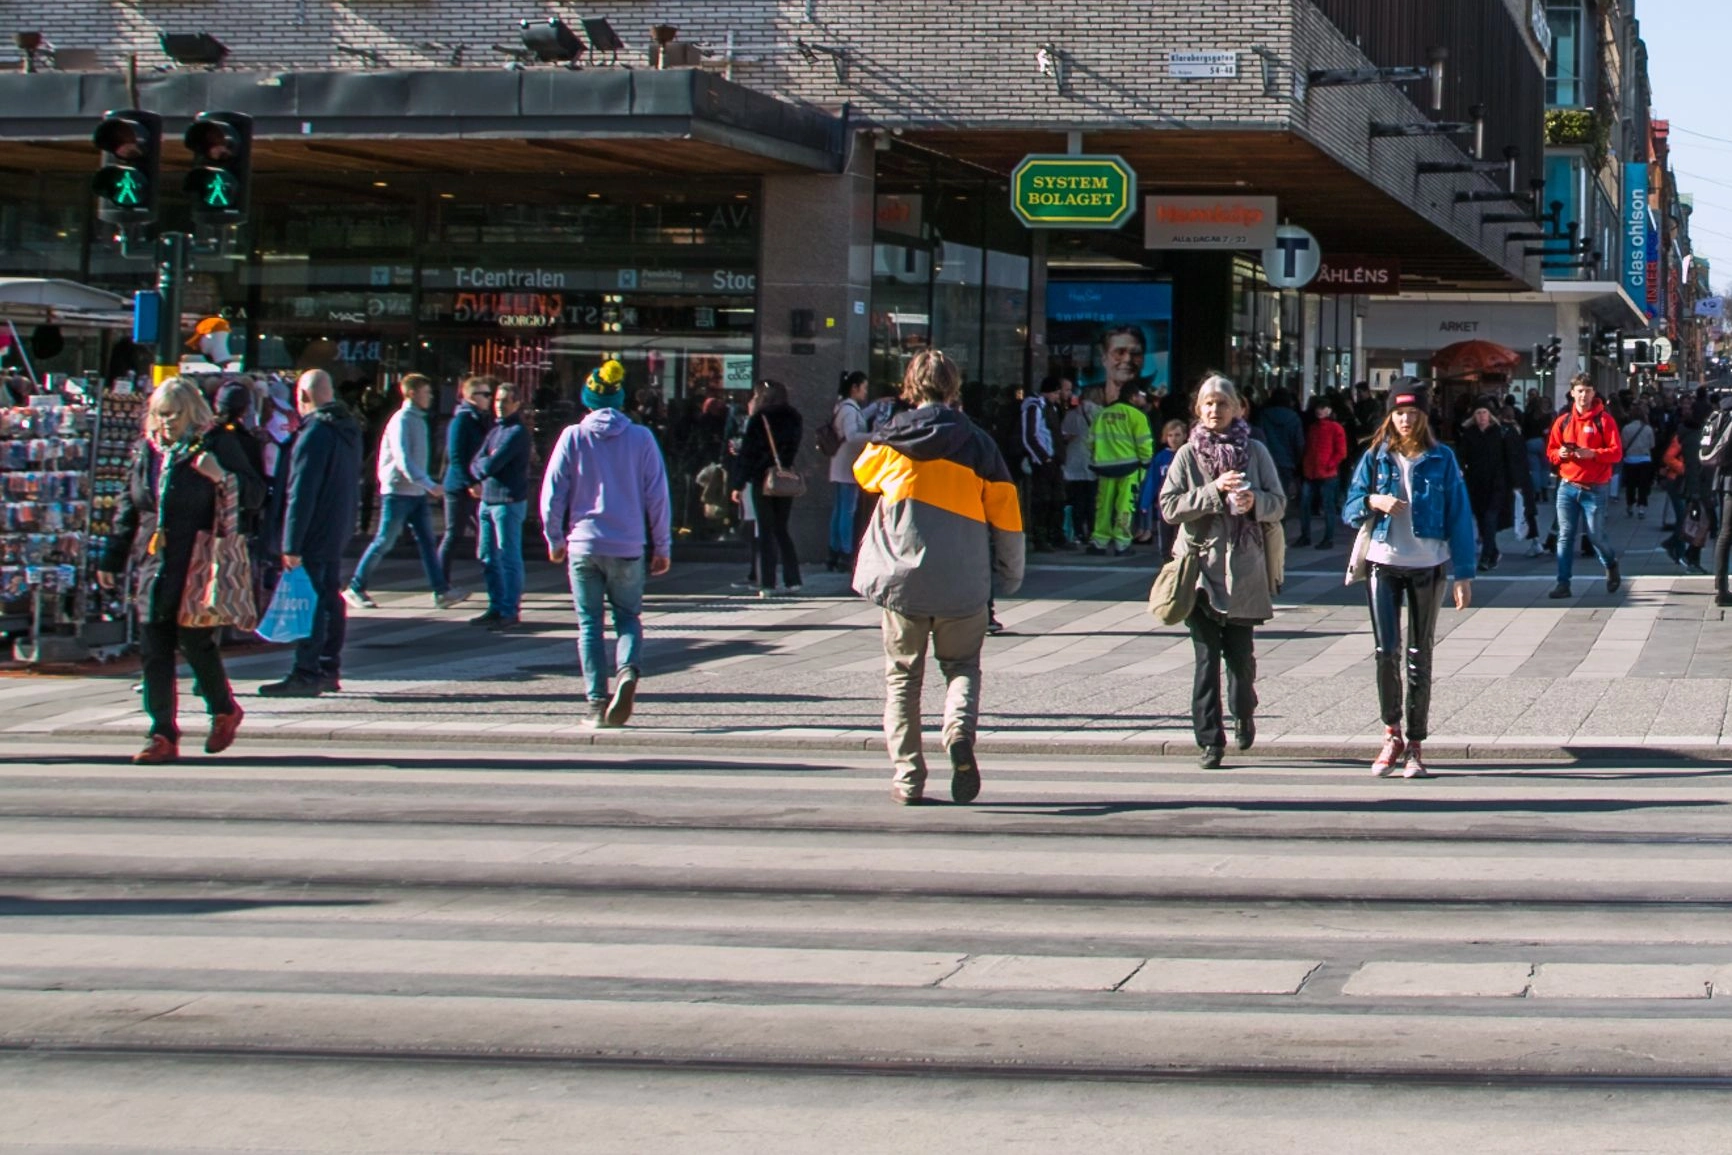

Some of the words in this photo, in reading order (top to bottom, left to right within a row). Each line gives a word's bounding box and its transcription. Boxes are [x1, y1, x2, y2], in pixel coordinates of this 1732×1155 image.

[1033, 176, 1109, 190] SYSTEM
[1027, 192, 1115, 207] BOLAGET
[1628, 189, 1645, 247] ohlson
[1276, 237, 1310, 278] T
[453, 267, 565, 287] T-Centralen
[1317, 264, 1388, 284] ÅHLÉNS
[1628, 250, 1644, 286] clas
[712, 269, 756, 290] Stoc
[329, 311, 366, 323] MAC
[1439, 321, 1479, 333] ARKET
